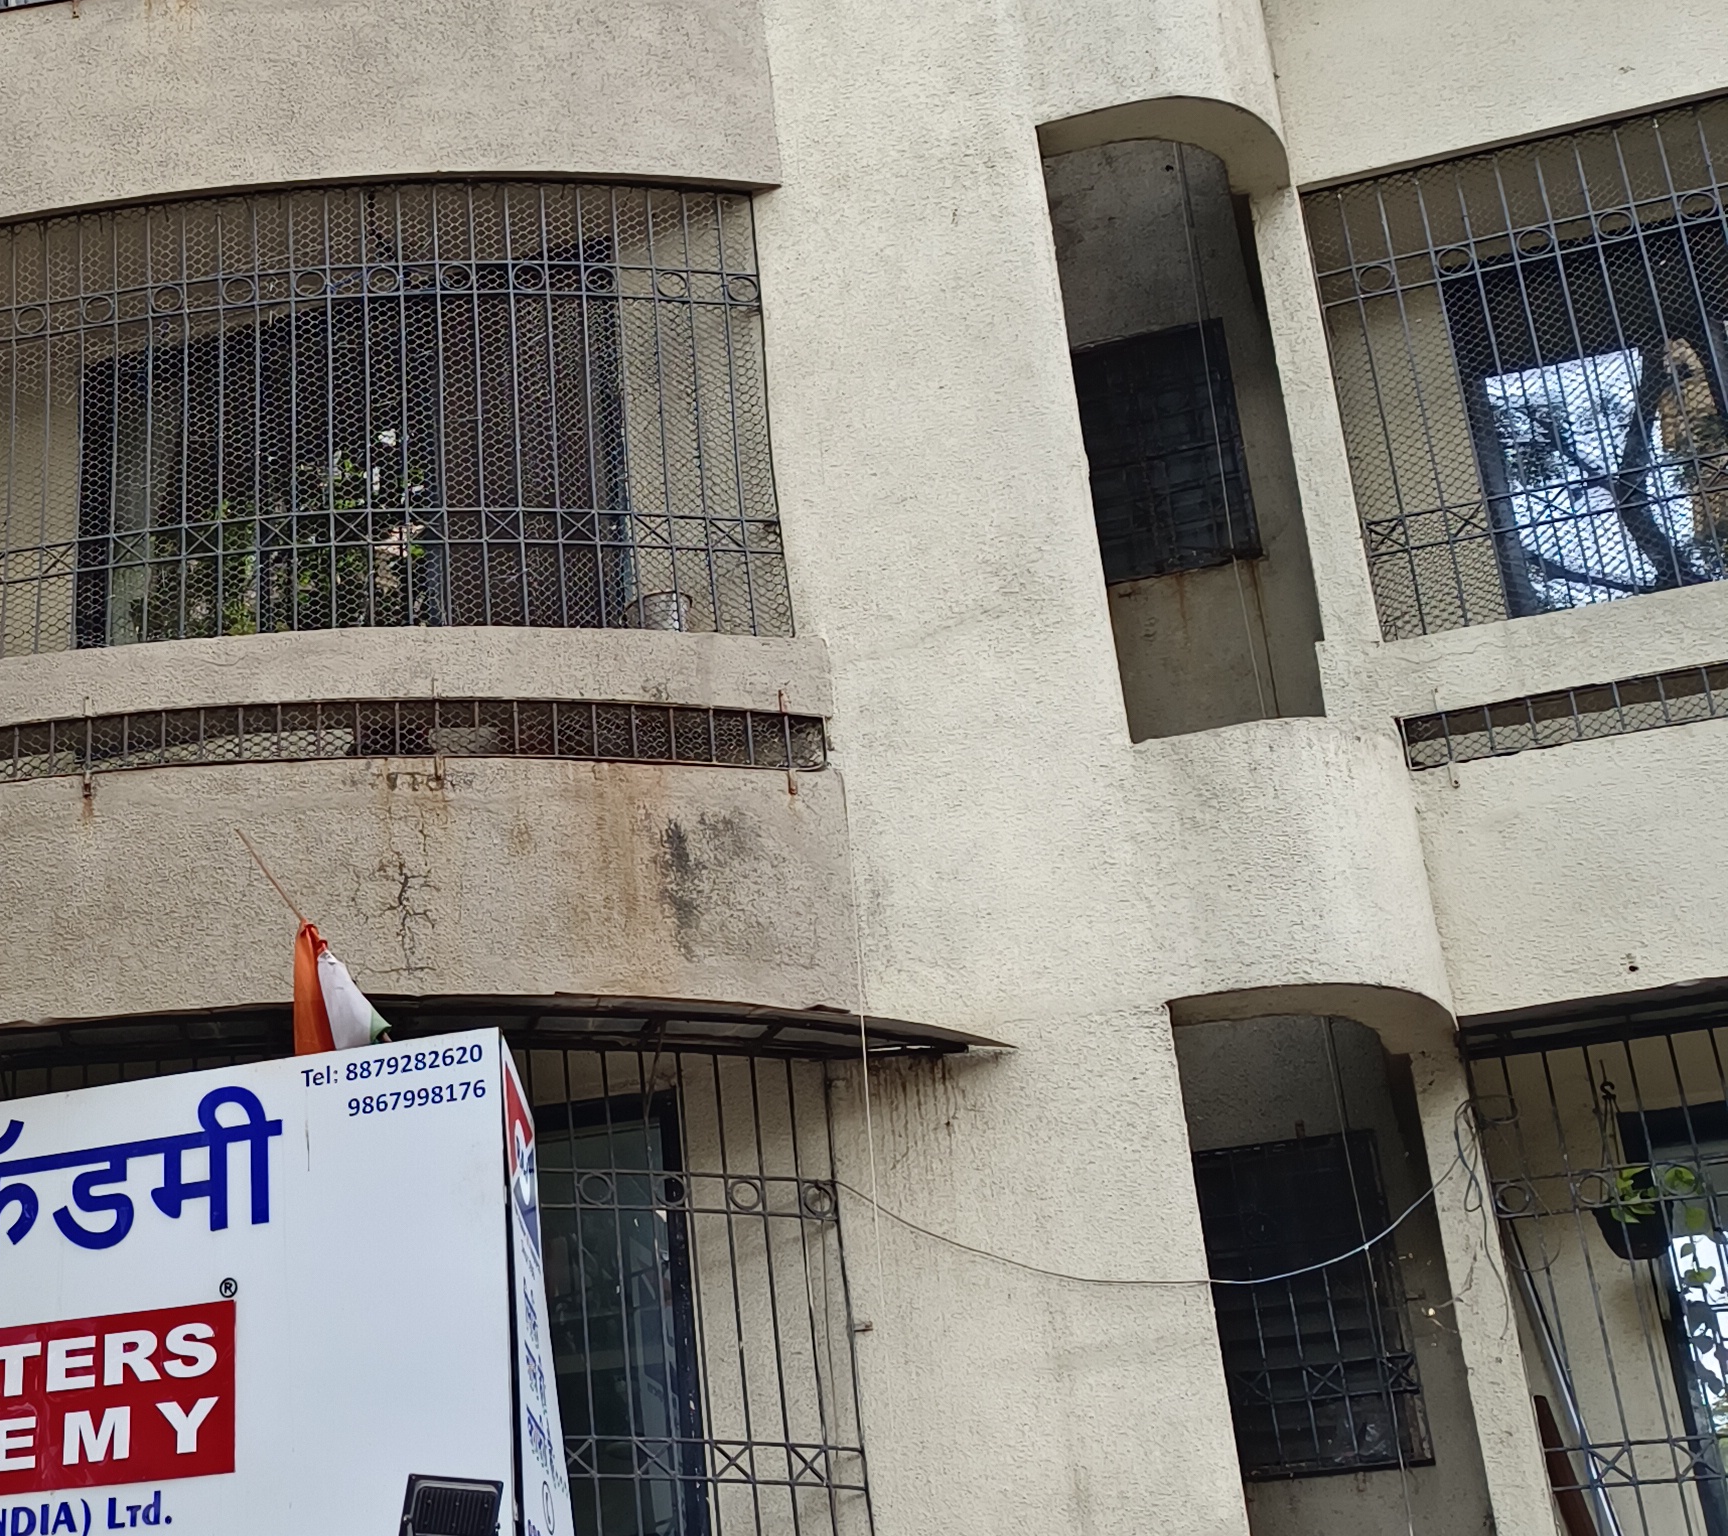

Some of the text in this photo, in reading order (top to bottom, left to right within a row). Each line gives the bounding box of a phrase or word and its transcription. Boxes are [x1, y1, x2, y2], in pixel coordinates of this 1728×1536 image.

[301, 1044, 483, 1088] Tel: 8879282620
[348, 1079, 486, 1117] 9867998176
